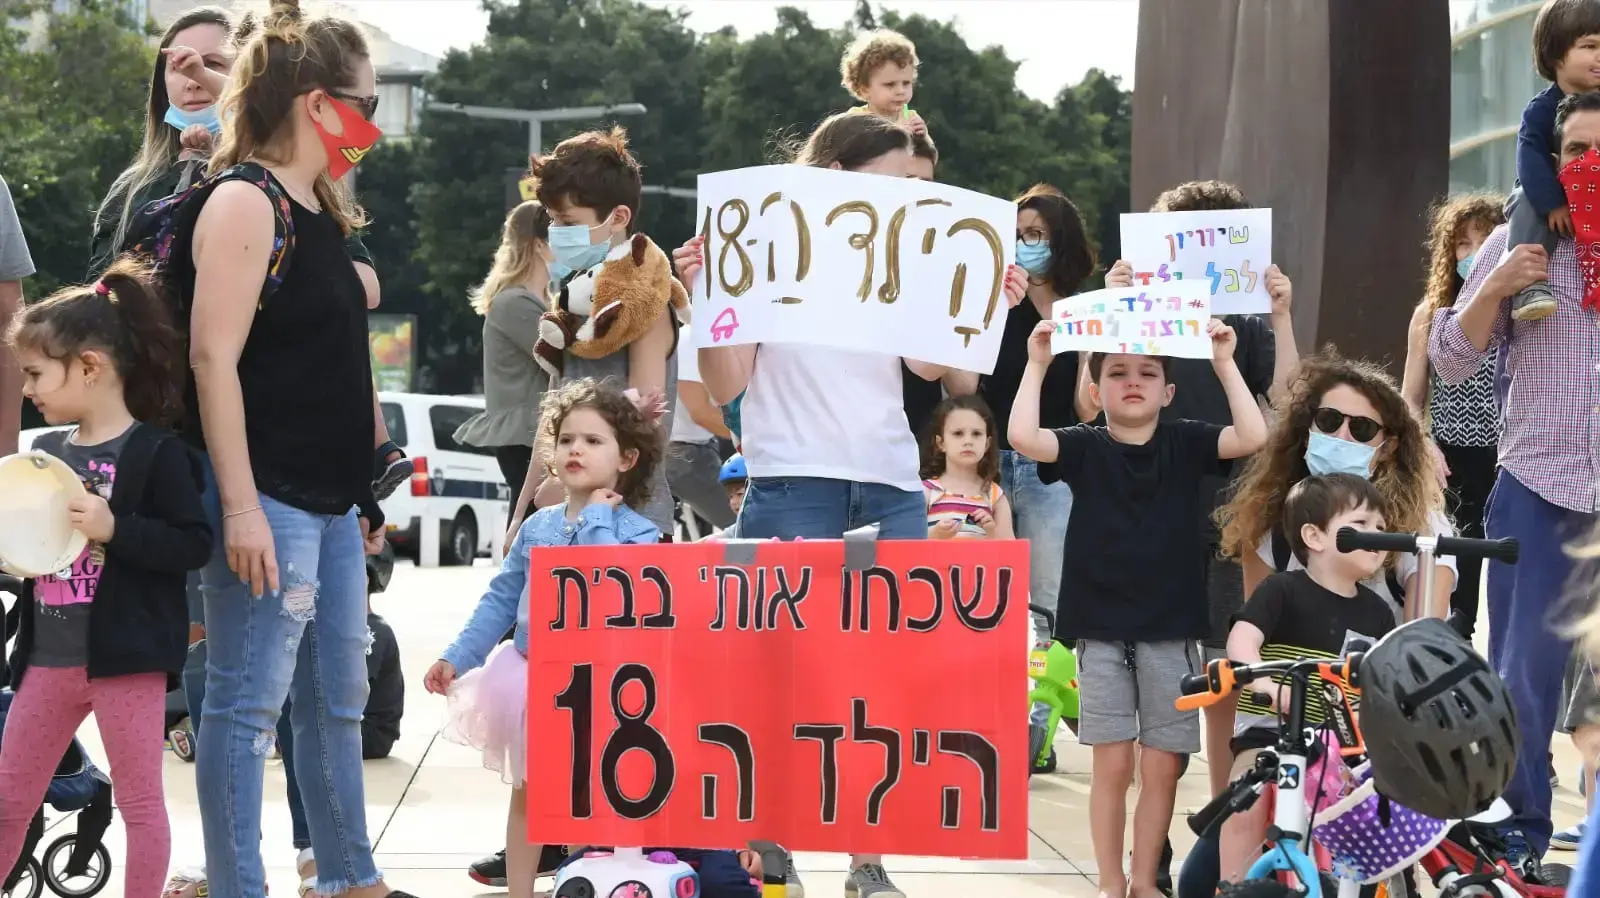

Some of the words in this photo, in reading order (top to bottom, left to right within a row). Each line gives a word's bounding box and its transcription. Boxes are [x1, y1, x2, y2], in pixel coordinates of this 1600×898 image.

[1164, 225, 1250, 263] שיוויון
[1205, 259, 1258, 296] לכל
[1140, 319, 1200, 337] רוצה
[549, 565, 677, 631] בבית
[697, 564, 813, 632] אותי
[840, 564, 1013, 632] שכחו
[792, 696, 1000, 833] הילד
